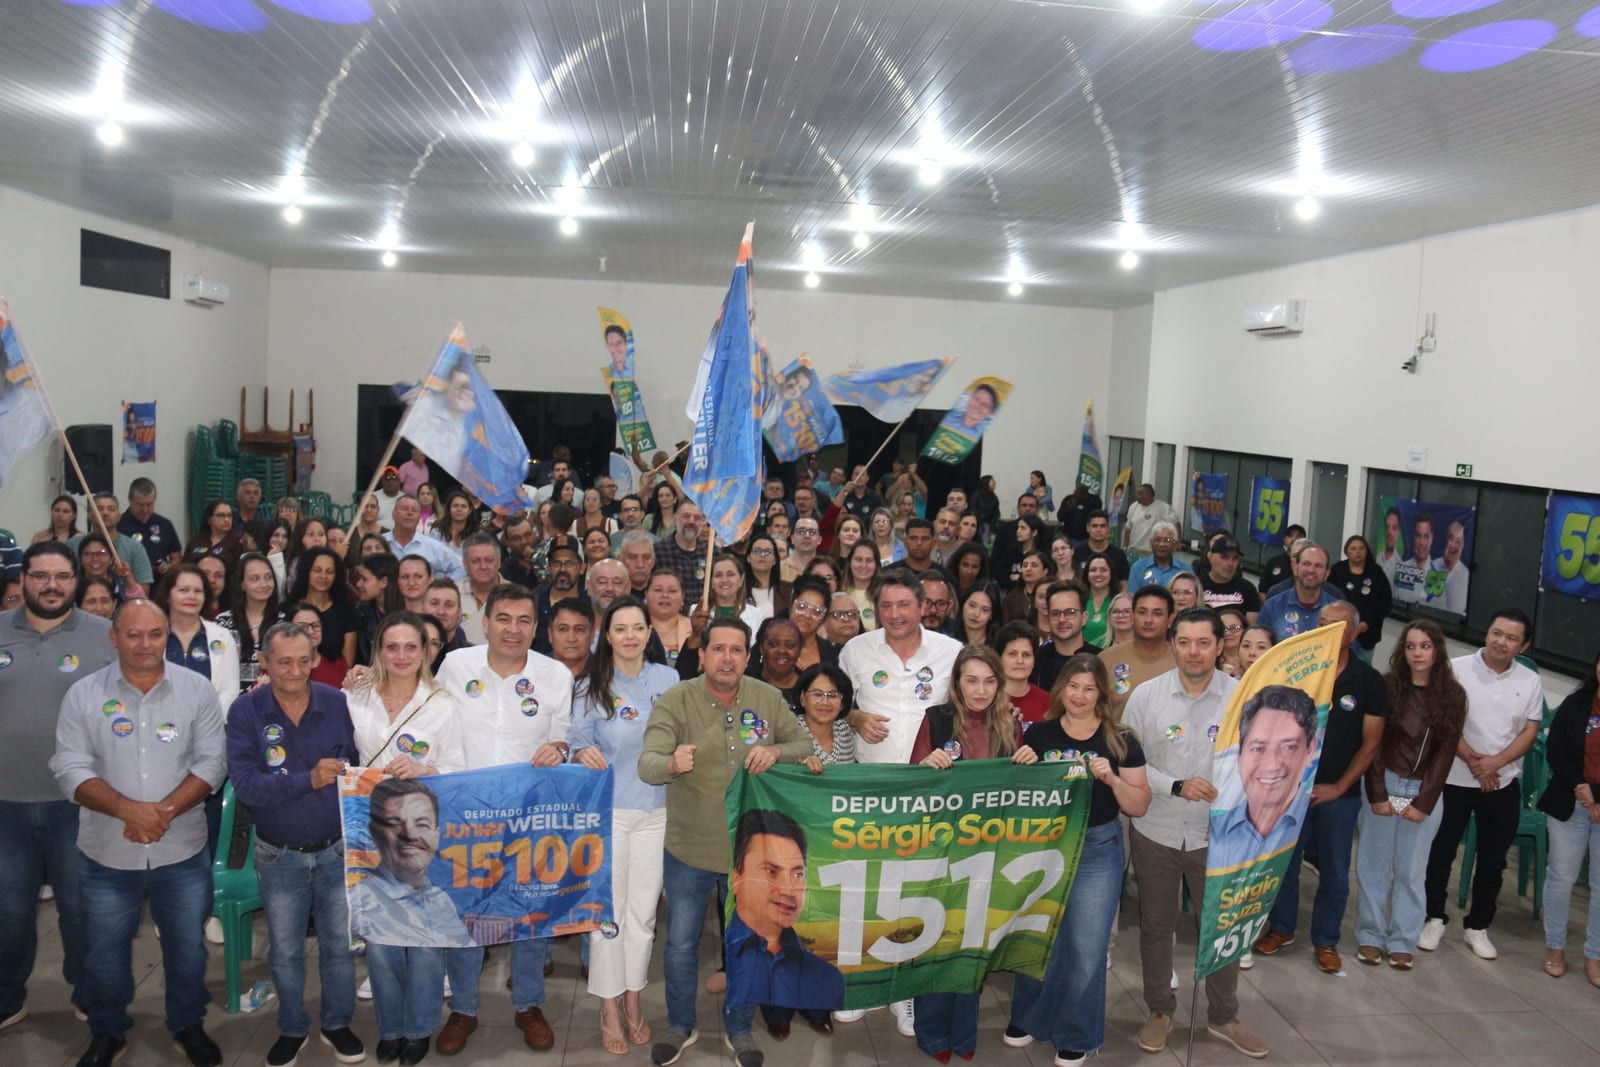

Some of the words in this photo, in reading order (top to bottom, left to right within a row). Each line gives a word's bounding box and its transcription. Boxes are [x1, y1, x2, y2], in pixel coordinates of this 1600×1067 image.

[1256, 488, 1285, 535] 55
[1286, 653, 1316, 673] NOSSA
[464, 808, 523, 820] DEPUTADO
[526, 801, 582, 814] ESTADUAL
[831, 794, 963, 814] DEPUTADO
[971, 788, 1073, 809] FEDERAL
[507, 811, 601, 833] WEILLER
[832, 816, 954, 855] Sérgio
[956, 813, 1067, 843] Souza
[439, 833, 604, 889] 15100
[816, 848, 1065, 967] 1512
